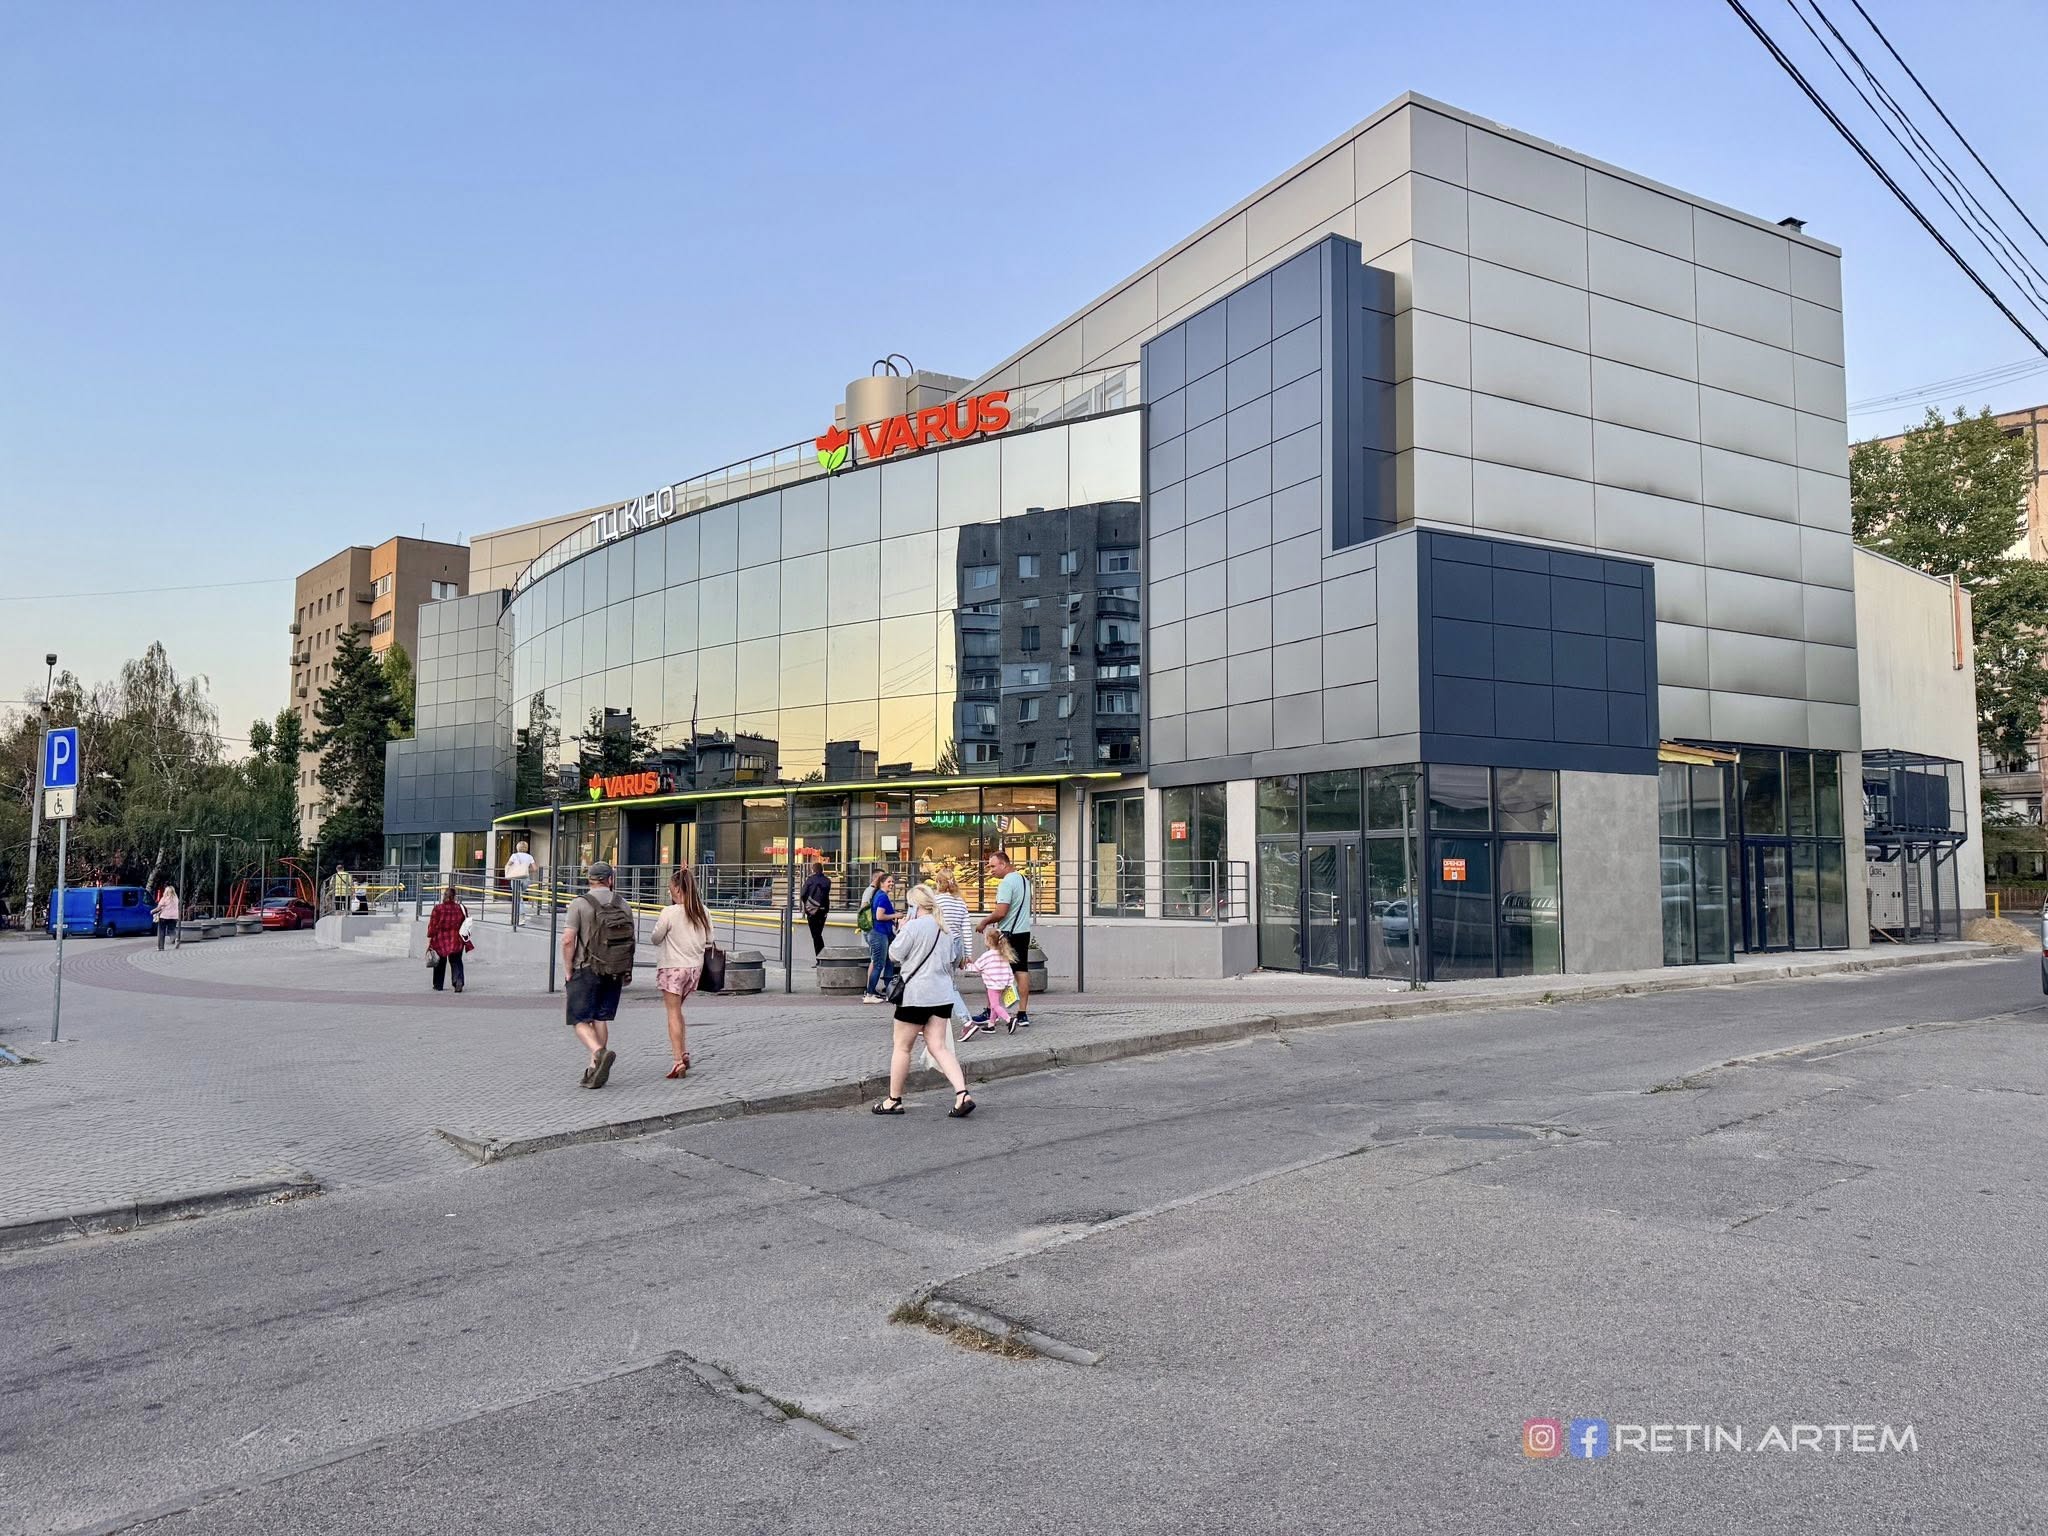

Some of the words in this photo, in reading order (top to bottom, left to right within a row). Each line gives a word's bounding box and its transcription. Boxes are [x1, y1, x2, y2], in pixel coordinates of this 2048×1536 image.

[857, 390, 1011, 460] VARUS
[591, 507, 619, 544] ТЦ
[624, 485, 674, 532] КІНО
[52, 735, 70, 781] P
[604, 771, 658, 798] VARUS
